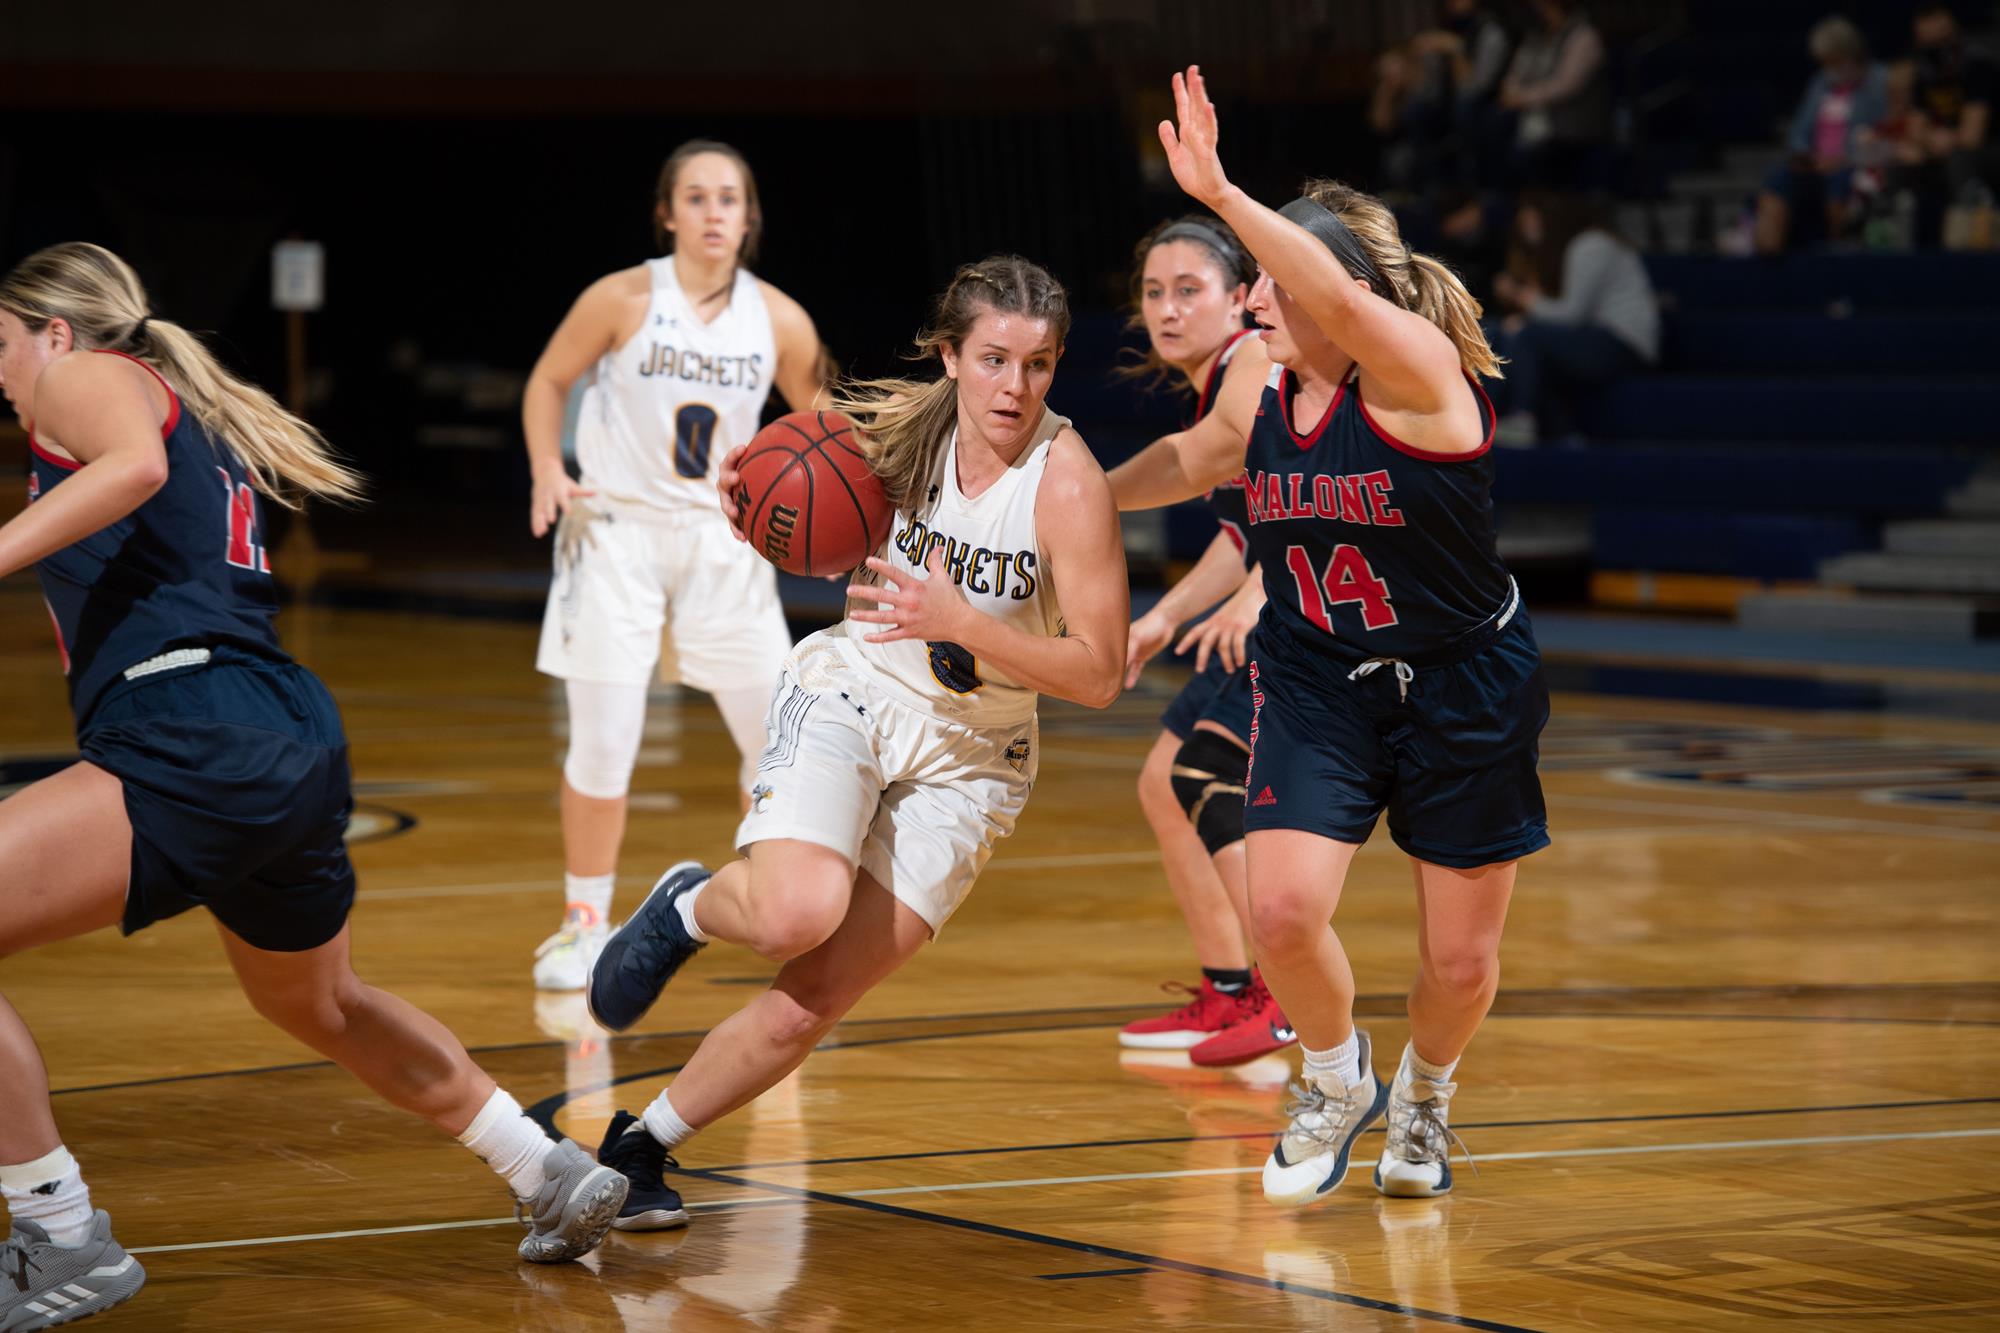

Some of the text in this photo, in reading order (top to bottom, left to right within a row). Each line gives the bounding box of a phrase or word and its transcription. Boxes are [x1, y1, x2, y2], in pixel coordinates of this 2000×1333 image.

[638, 341, 761, 390] JACKETS
[672, 402, 719, 480] 0
[1244, 467, 1406, 527] MALONE
[1286, 544, 1399, 635] 14
